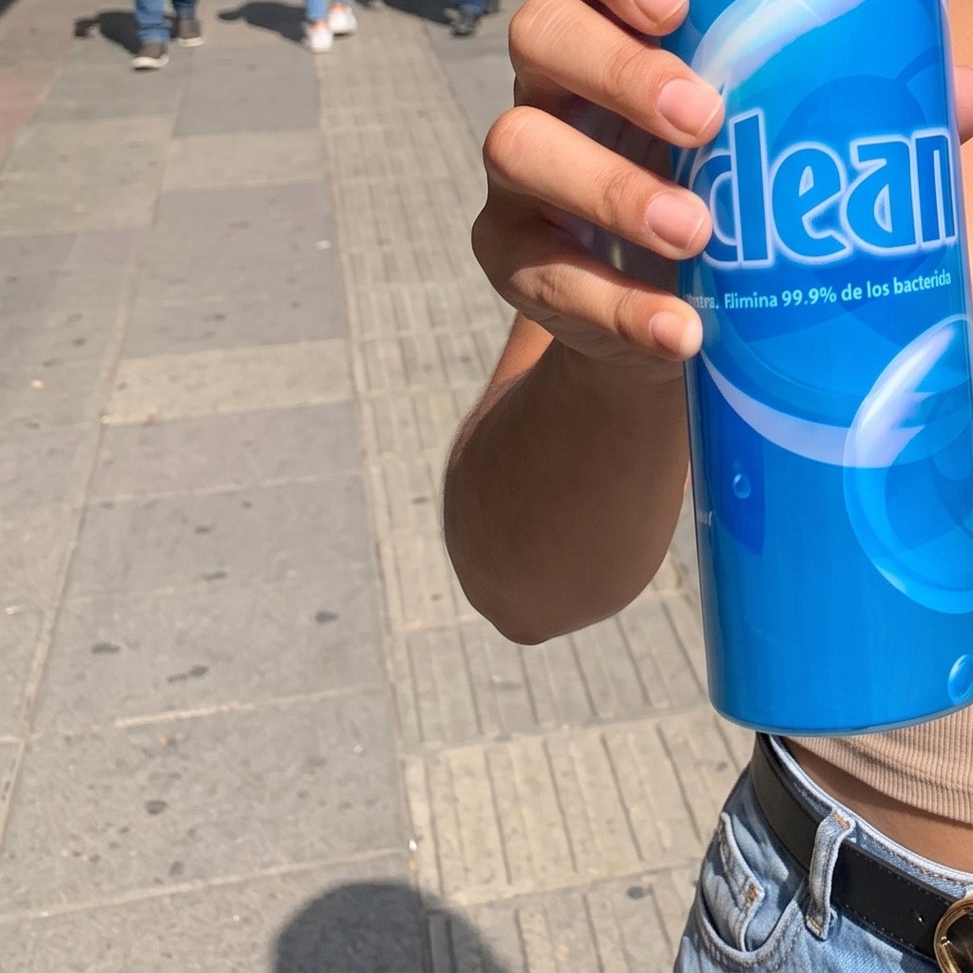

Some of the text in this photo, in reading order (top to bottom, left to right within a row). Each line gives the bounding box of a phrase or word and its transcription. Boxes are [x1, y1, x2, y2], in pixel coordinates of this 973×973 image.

[781, 286, 837, 307] 99.9%
[841, 283, 862, 301] de
[867, 280, 890, 298] los
[893, 268, 952, 295] bacterida
